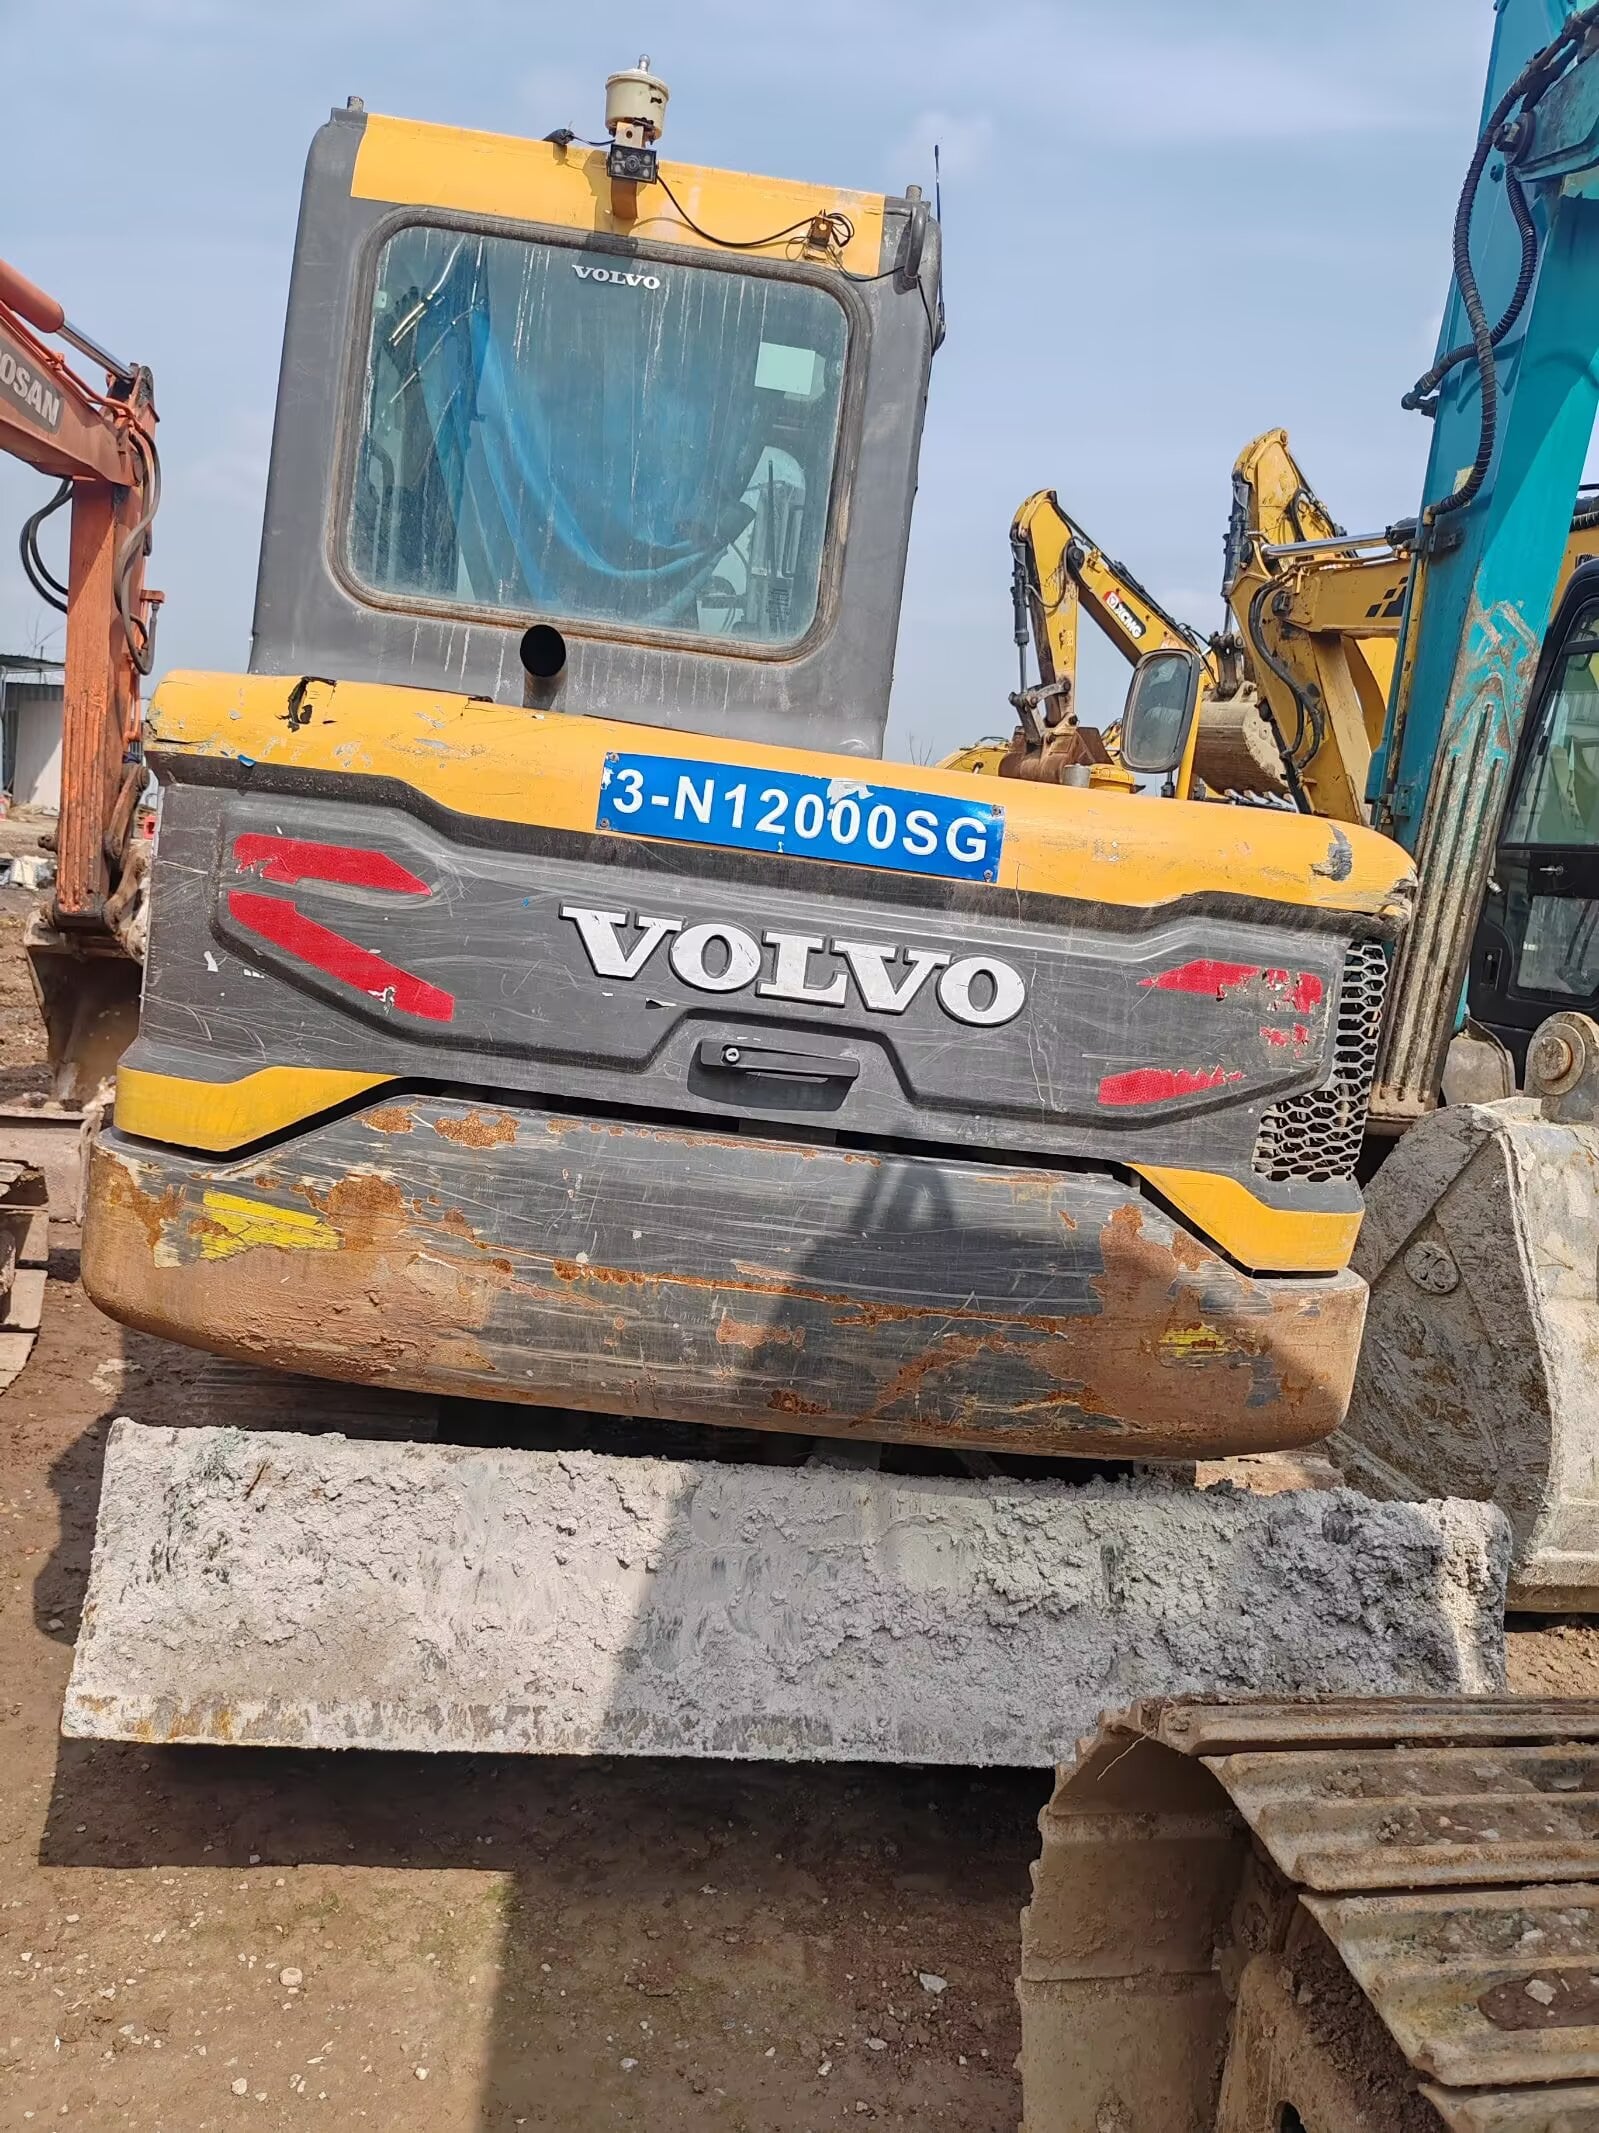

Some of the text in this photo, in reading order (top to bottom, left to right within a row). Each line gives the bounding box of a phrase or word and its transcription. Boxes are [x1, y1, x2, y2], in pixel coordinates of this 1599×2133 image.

[571, 264, 661, 290] VOLVO
[0, 349, 60, 427] OSAN
[1114, 603, 1142, 639] XCMG
[612, 768, 988, 862] 3-N12000SG
[560, 904, 1026, 1026] VOLVO
